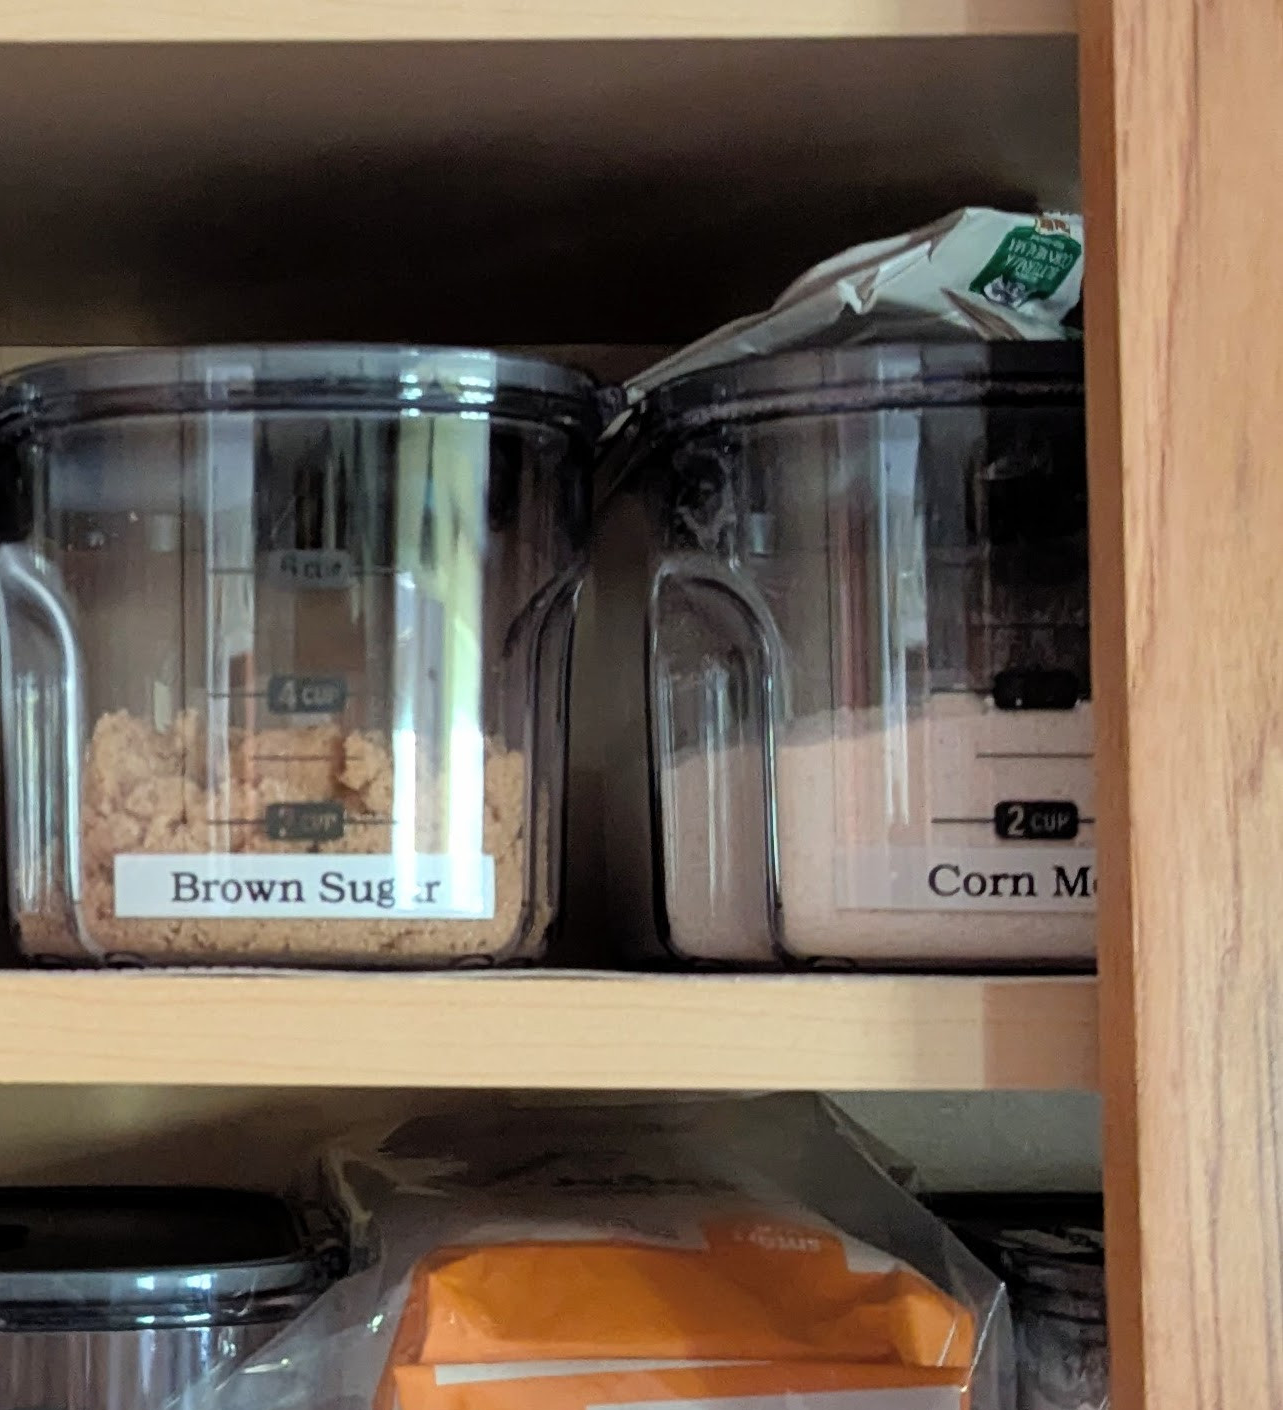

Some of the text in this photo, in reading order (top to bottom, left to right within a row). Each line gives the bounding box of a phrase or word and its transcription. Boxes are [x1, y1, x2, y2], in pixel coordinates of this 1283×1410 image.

[1007, 805, 1071, 836] 2 CUP
[171, 871, 441, 910] Brown Sugr
[928, 863, 1097, 898] Corn M
